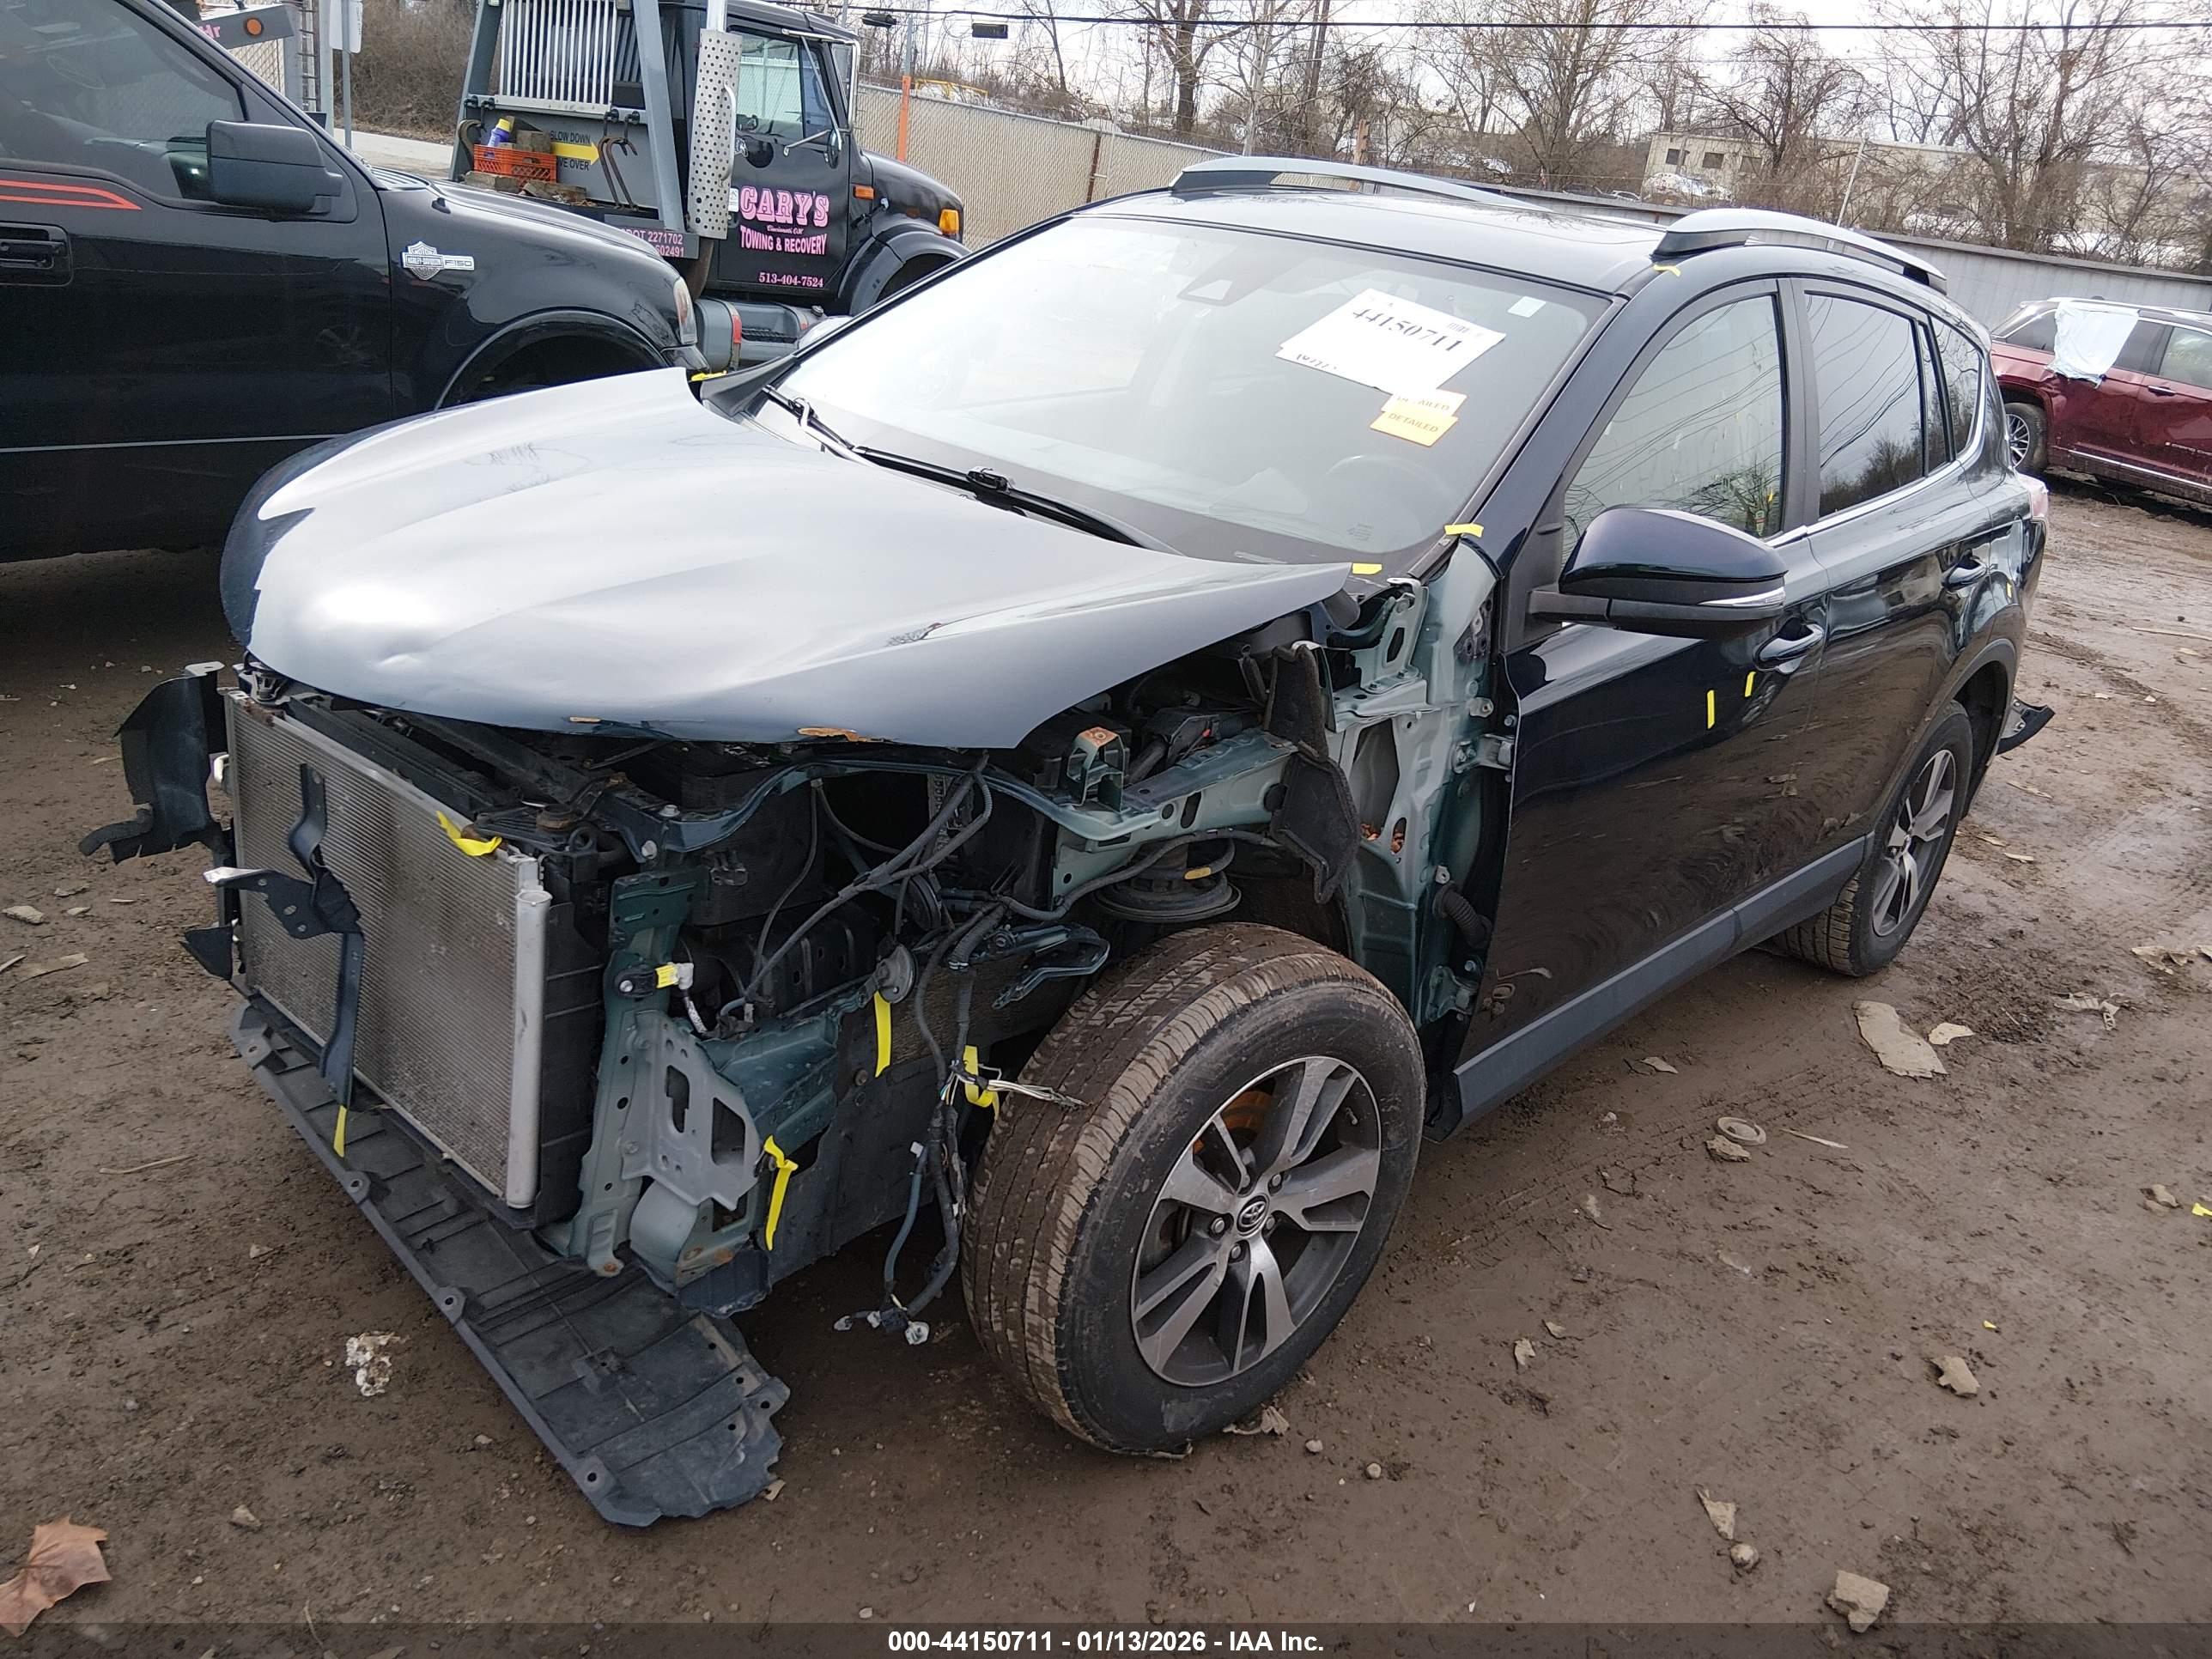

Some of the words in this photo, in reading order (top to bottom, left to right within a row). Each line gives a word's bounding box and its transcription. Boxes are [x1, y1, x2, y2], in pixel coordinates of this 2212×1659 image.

[550, 130, 569, 143] SLOW
[570, 131, 591, 143] DOWN
[569, 159, 589, 171] OVER
[739, 185, 830, 228] CARY'S
[647, 231, 683, 245] 2271702
[740, 225, 774, 252] TOWING
[775, 238, 783, 252] &
[784, 234, 828, 255] RECOVERY
[758, 272, 824, 288] 513-404-7524
[1352, 308, 1463, 351] 44150711
[1388, 412, 1439, 433] DETAILED
